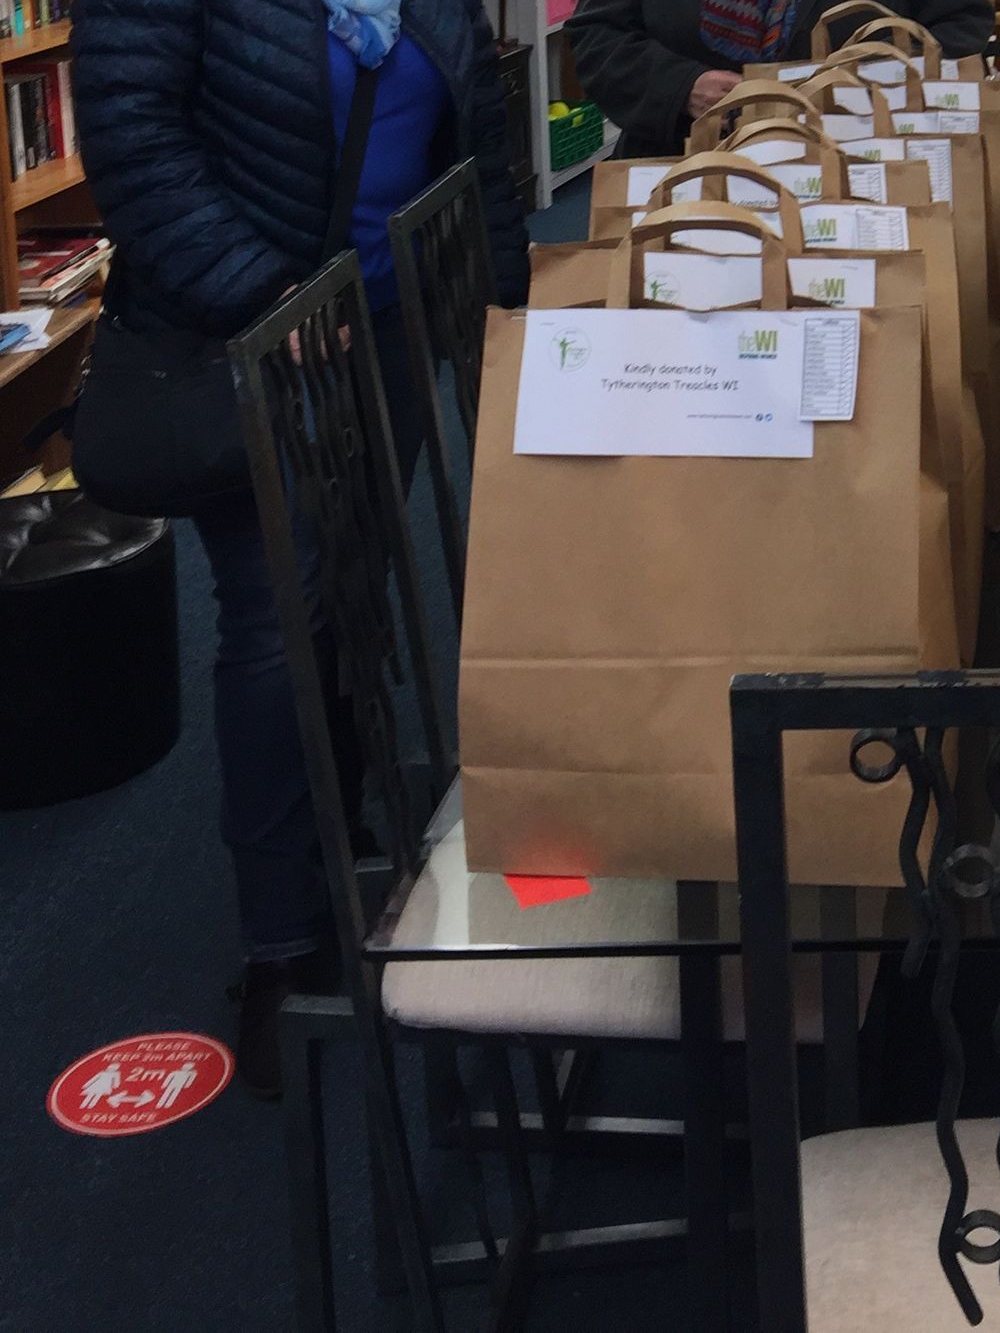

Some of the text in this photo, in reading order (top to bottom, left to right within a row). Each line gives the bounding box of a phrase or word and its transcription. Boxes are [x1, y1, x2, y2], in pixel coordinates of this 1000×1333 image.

[624, 364, 718, 376] Kindly donated by
[601, 378, 670, 392] Tytherington
[674, 379, 719, 390] Treacles
[137, 1041, 192, 1051] PLEASE
[102, 1052, 142, 1062] KEEP
[165, 1051, 212, 1061] APART
[125, 1066, 166, 1082] 2m
[80, 1113, 158, 1124] STAY SAFE
